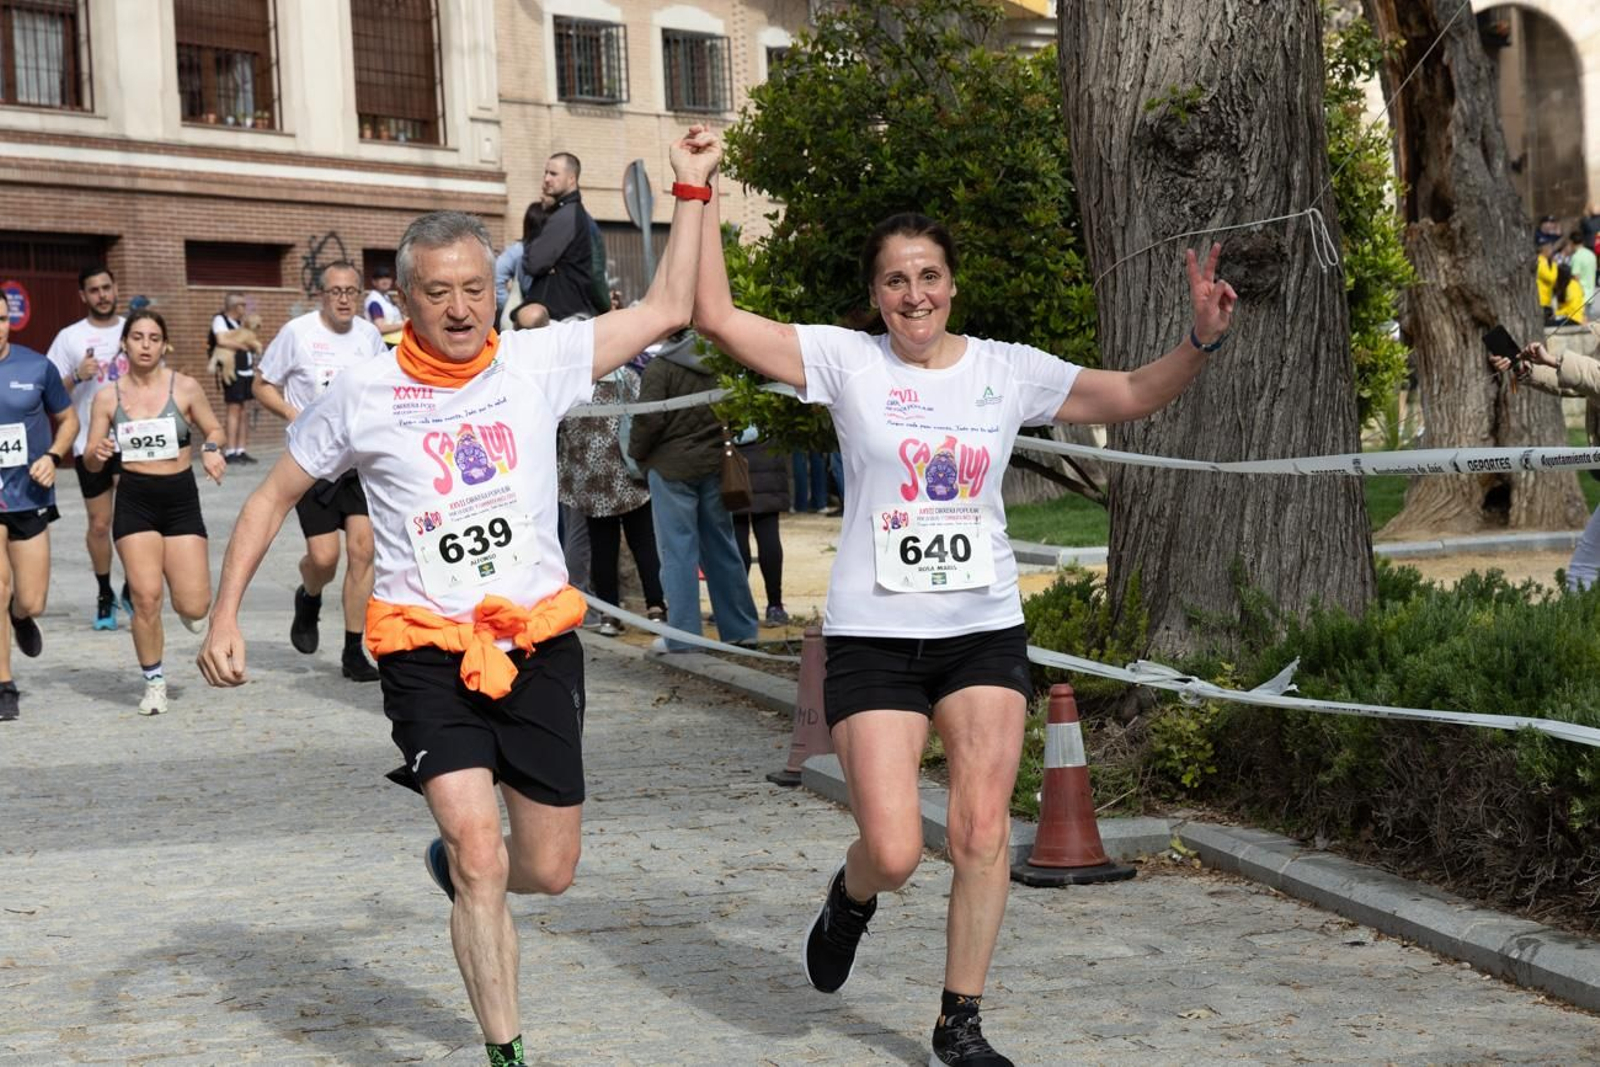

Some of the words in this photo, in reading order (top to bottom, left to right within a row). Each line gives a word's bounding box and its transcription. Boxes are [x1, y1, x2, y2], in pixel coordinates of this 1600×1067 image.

[393, 386, 434, 400] XXVII
[130, 434, 166, 449] 925
[1467, 457, 1512, 472] DEPORTES
[1540, 454, 1592, 469] Ayuntamiento
[439, 517, 512, 564] 639
[900, 534, 972, 565] 640
